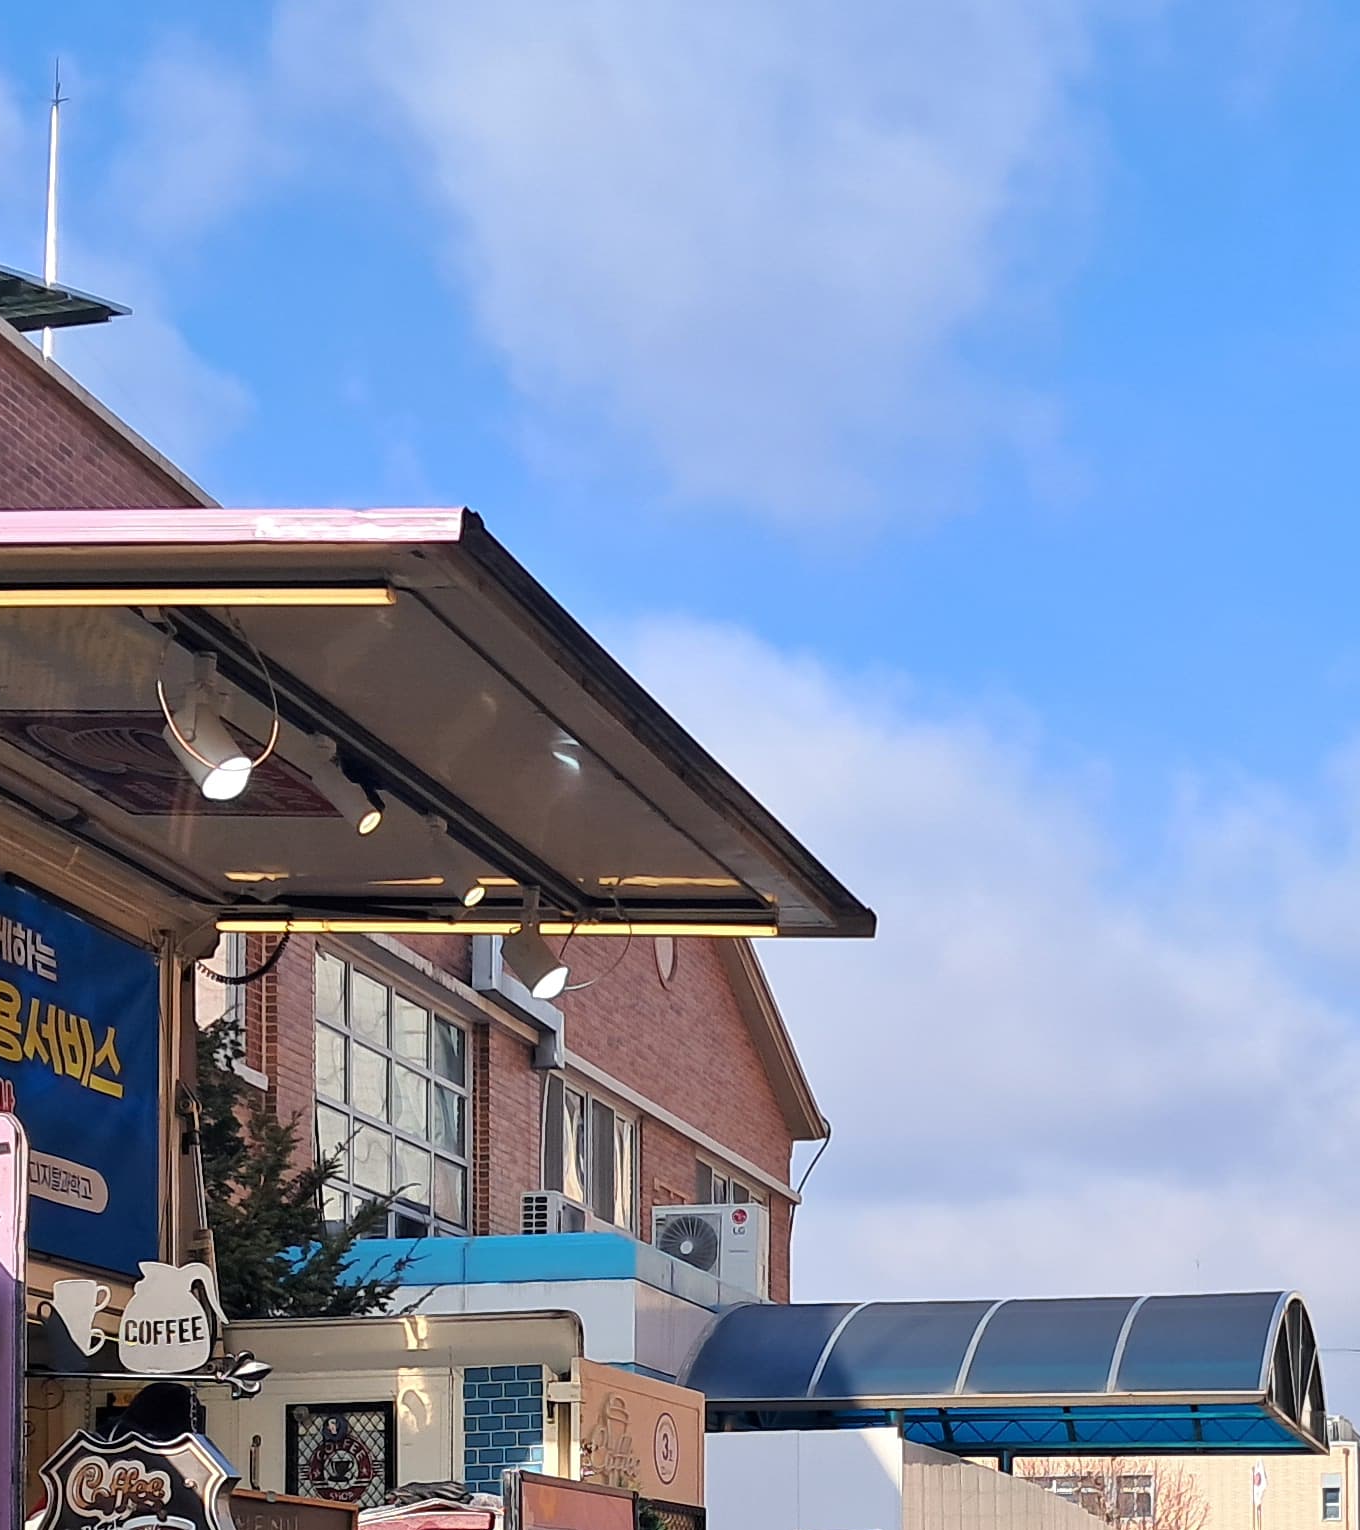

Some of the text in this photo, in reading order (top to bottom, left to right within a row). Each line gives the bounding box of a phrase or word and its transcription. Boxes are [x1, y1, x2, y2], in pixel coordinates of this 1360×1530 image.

[732, 1226, 746, 1236] LG
[124, 1315, 205, 1345] COFFEE
[70, 1460, 169, 1518] Coffee
